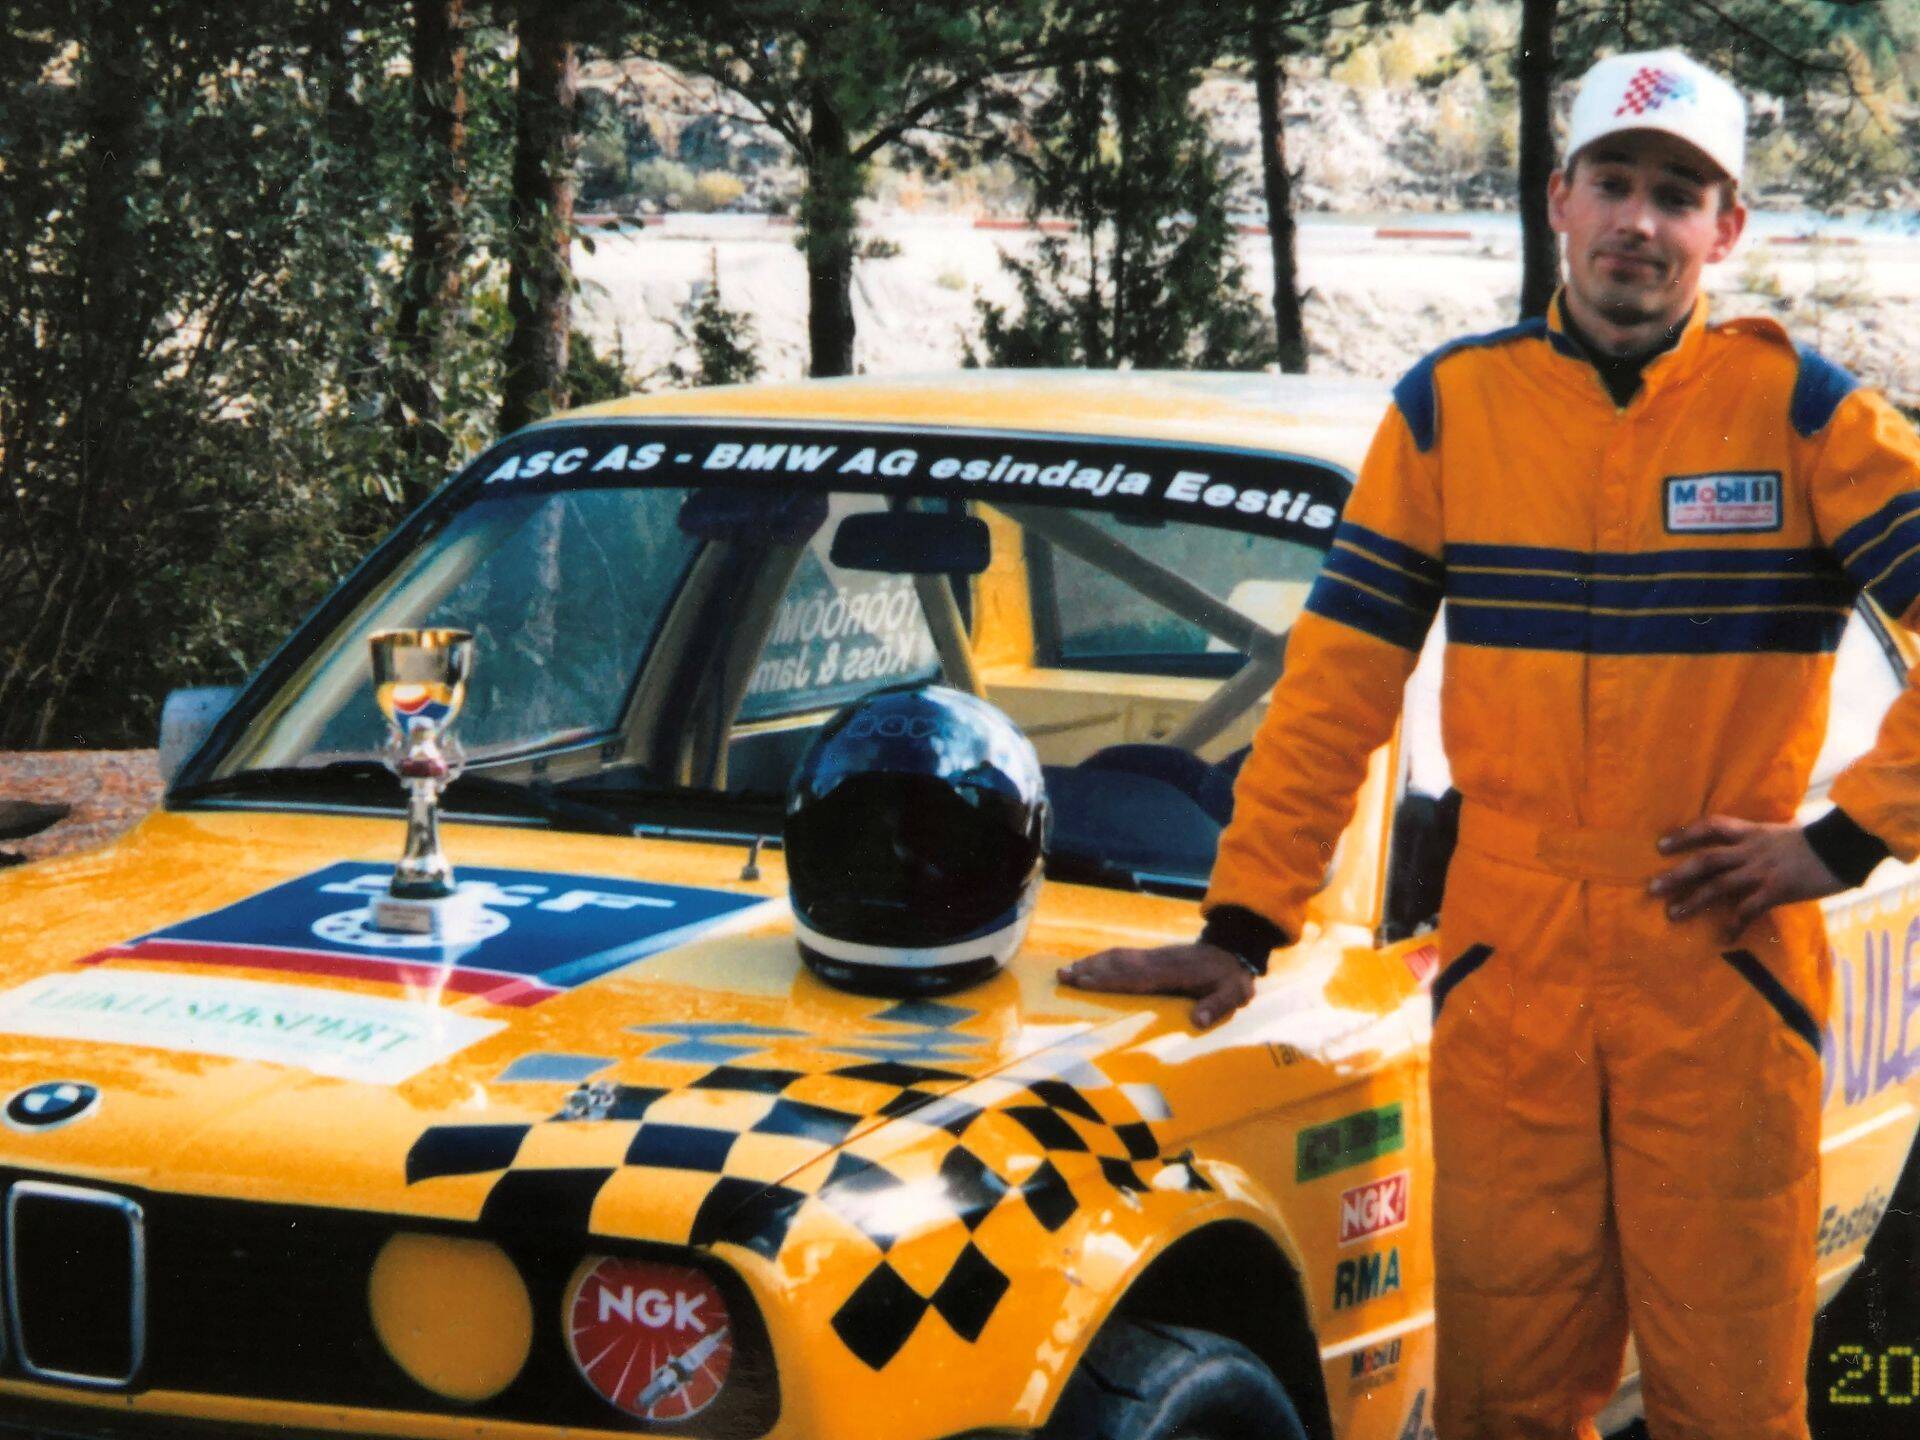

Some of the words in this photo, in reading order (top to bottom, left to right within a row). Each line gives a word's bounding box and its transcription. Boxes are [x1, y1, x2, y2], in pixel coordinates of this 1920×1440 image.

[484, 447, 588, 484] ASC
[590, 442, 666, 472] AS
[702, 442, 838, 472] BMW
[839, 447, 918, 476] AG
[929, 455, 1151, 497] esindaja
[1164, 469, 1336, 530] Eestis
[1342, 1179, 1397, 1237] NGK
[1333, 1247, 1400, 1310] RMA
[597, 1285, 708, 1333] NGK
